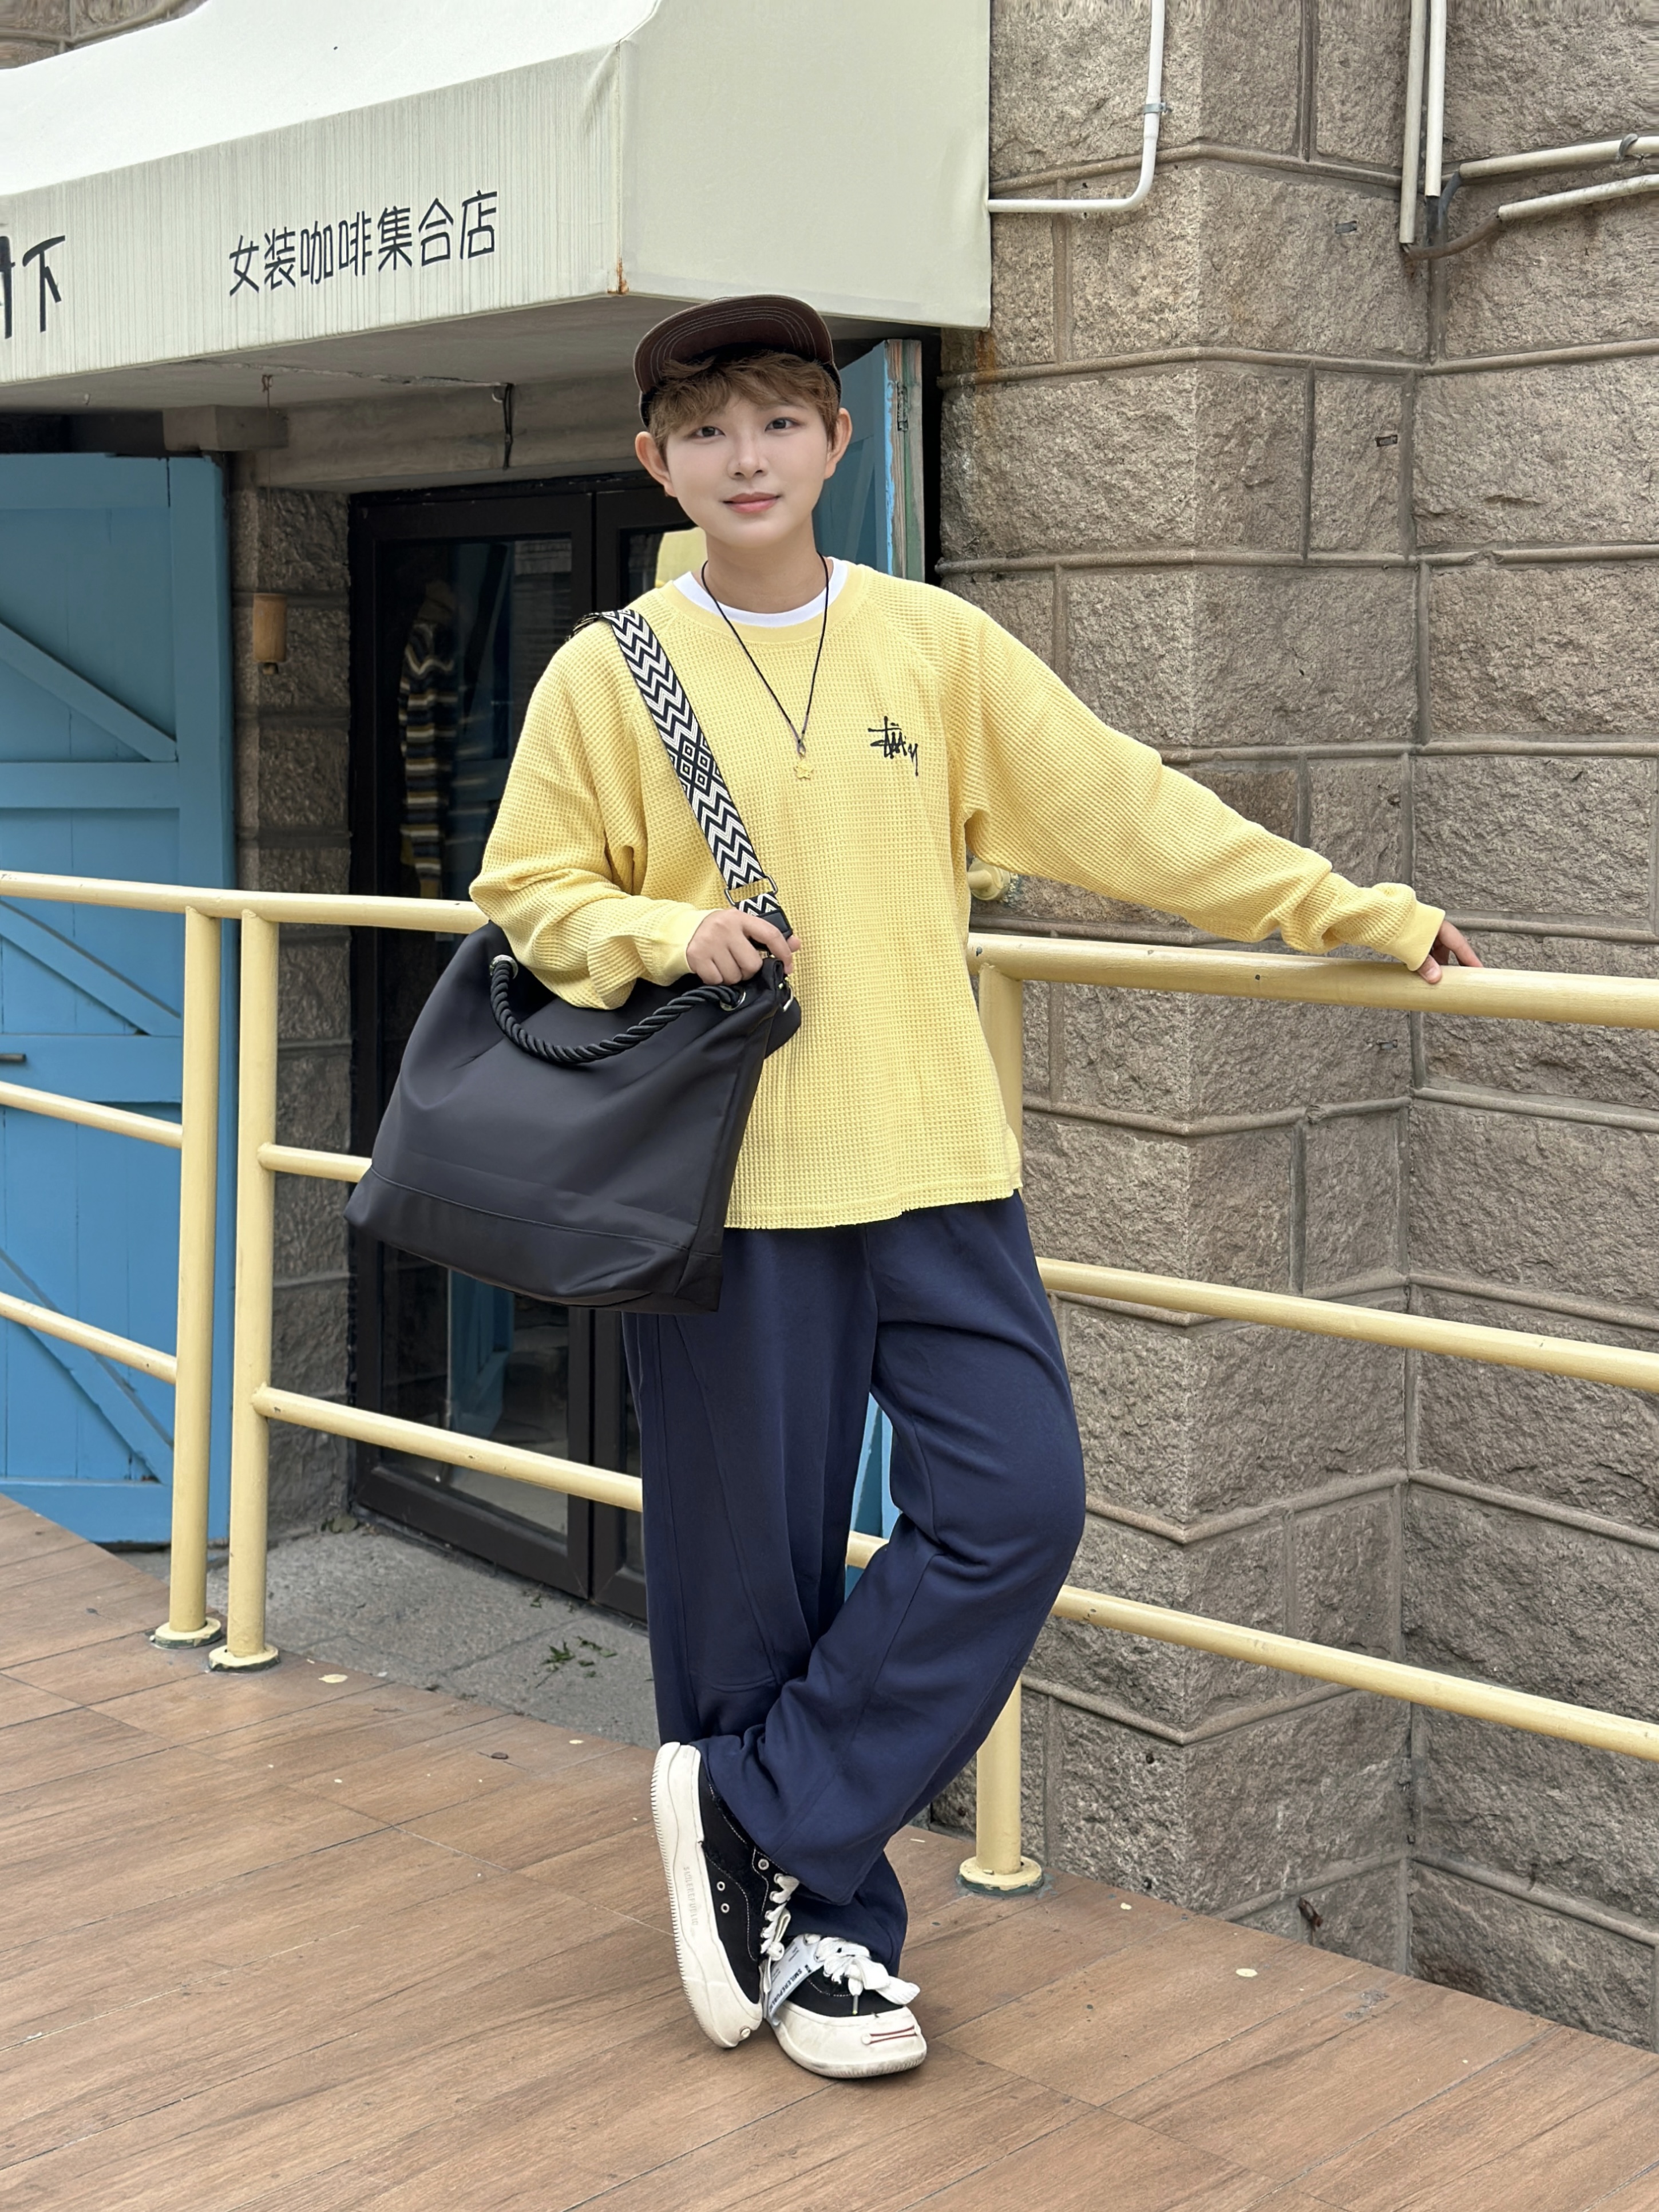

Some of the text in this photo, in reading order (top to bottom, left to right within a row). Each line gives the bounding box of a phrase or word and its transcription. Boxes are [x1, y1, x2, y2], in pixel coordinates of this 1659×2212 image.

[229, 189, 497, 296] 女装咖啡集合店
